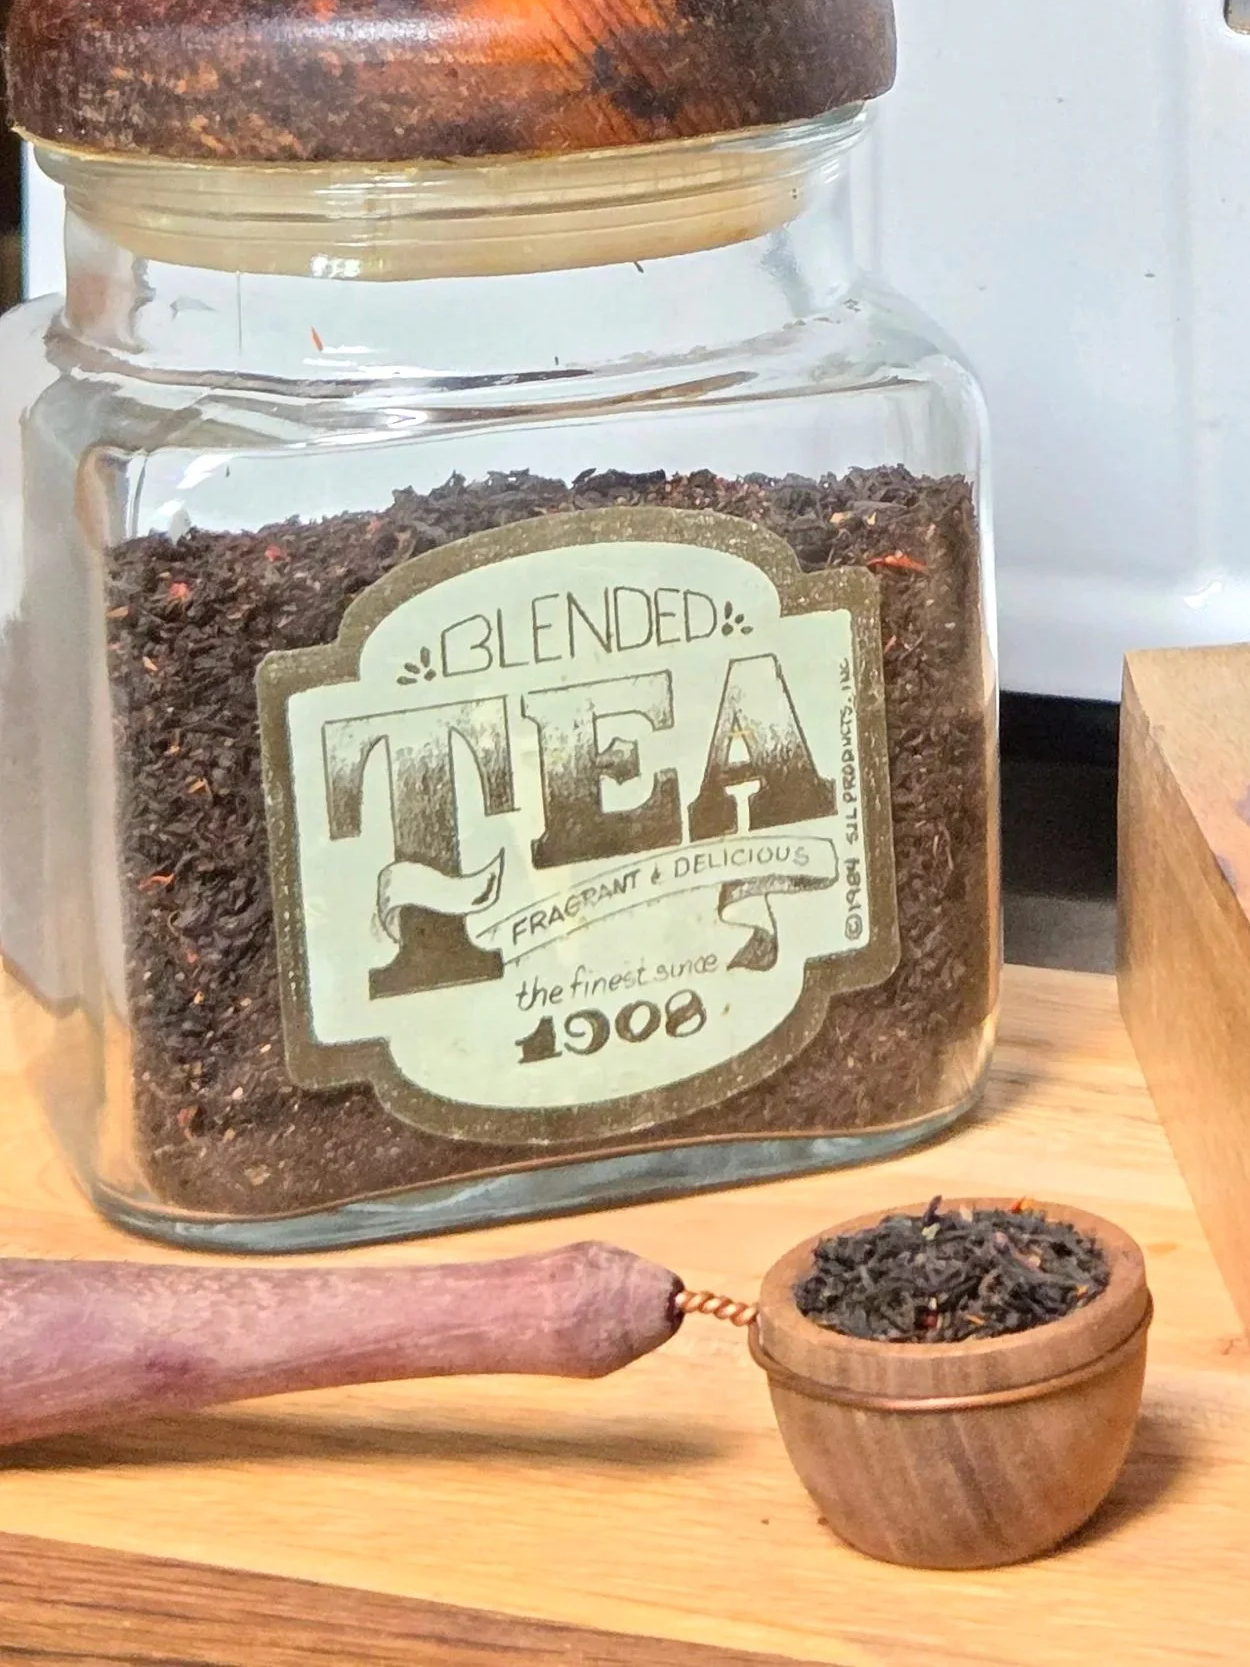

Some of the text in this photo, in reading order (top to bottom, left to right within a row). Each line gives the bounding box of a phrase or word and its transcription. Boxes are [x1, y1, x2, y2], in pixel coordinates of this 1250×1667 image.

[439, 586, 718, 678] BLENDED
[321, 652, 840, 1001] TEA
[511, 866, 642, 945] FRAGRANT
[673, 845, 811, 880] DELICIOUS
[514, 988, 708, 1064] 1908
[515, 953, 721, 1012] the finest since
